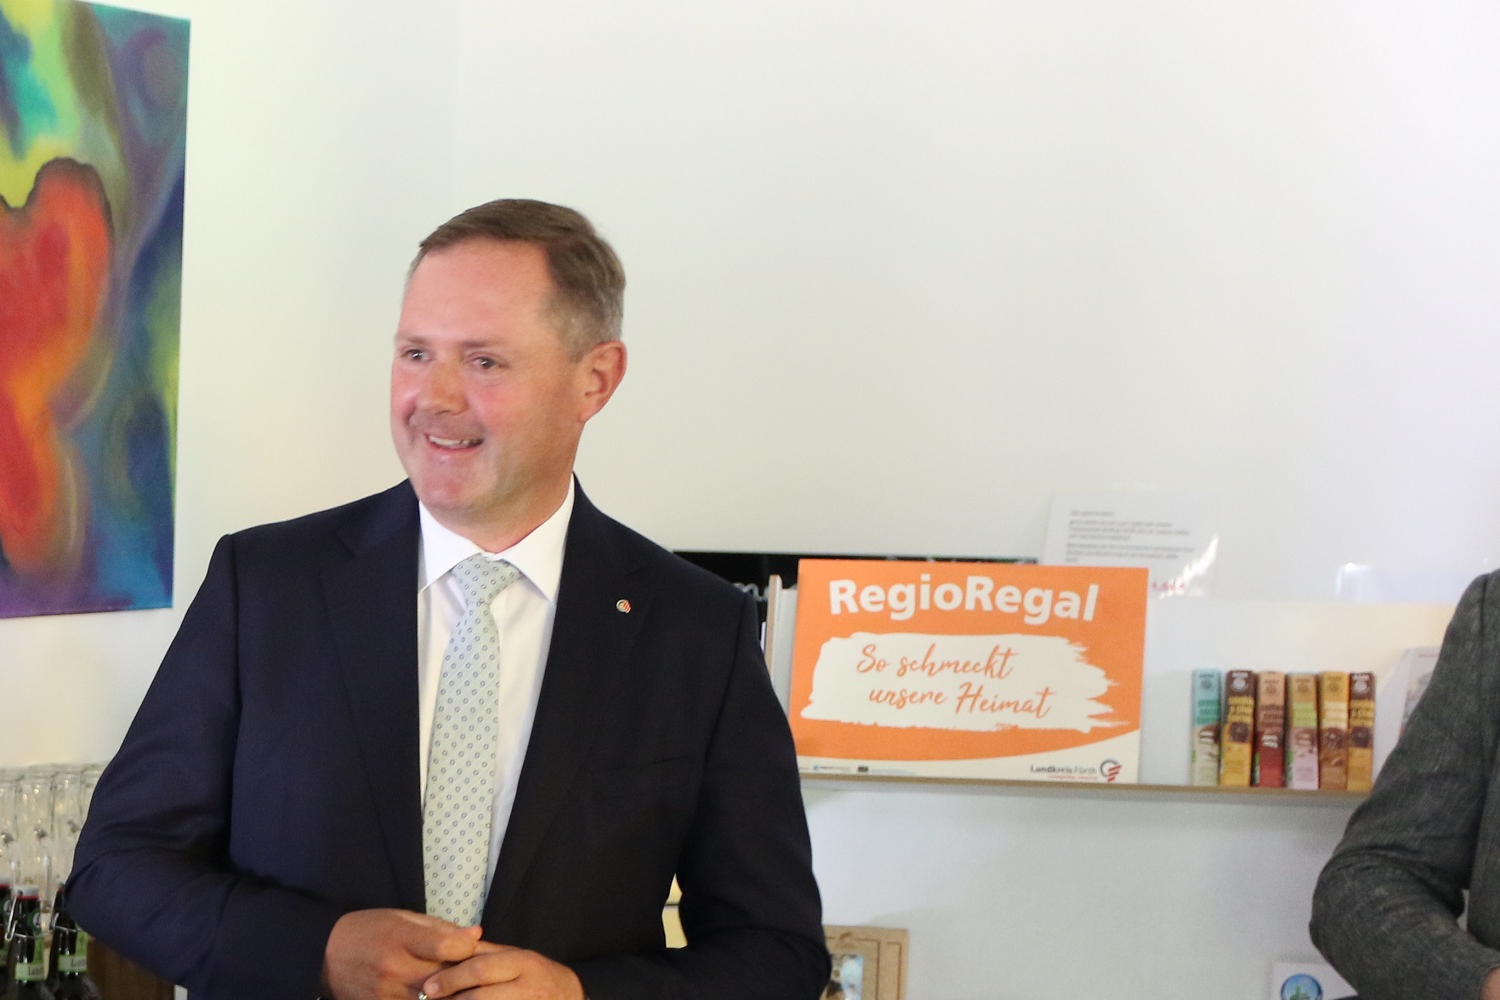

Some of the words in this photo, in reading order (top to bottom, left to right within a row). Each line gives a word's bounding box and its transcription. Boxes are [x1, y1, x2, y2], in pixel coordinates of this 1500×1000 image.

[829, 574, 1099, 625] RegioRegal
[857, 644, 889, 673] So
[897, 643, 1018, 679] schmeckt
[869, 686, 947, 709] unsere
[955, 682, 1056, 718] Heimat
